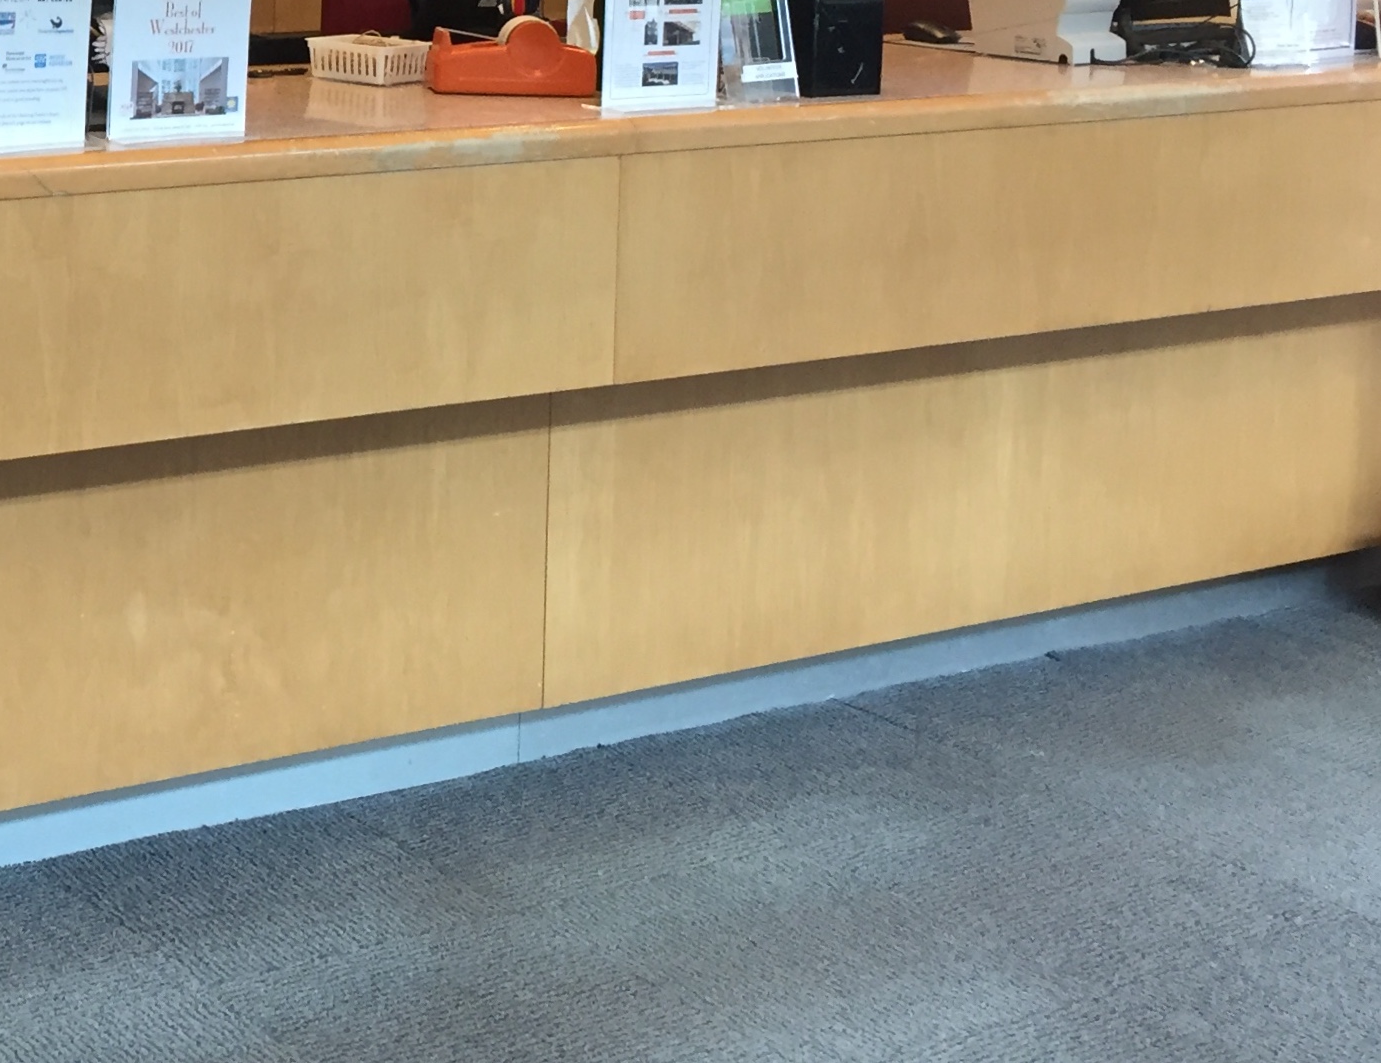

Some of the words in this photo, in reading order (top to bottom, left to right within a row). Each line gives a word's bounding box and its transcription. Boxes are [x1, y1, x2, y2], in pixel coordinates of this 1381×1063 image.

[165, 1, 188, 18] Best
[191, 0, 202, 18] of
[150, 18, 216, 35] Westchester
[168, 40, 194, 54] 2017
